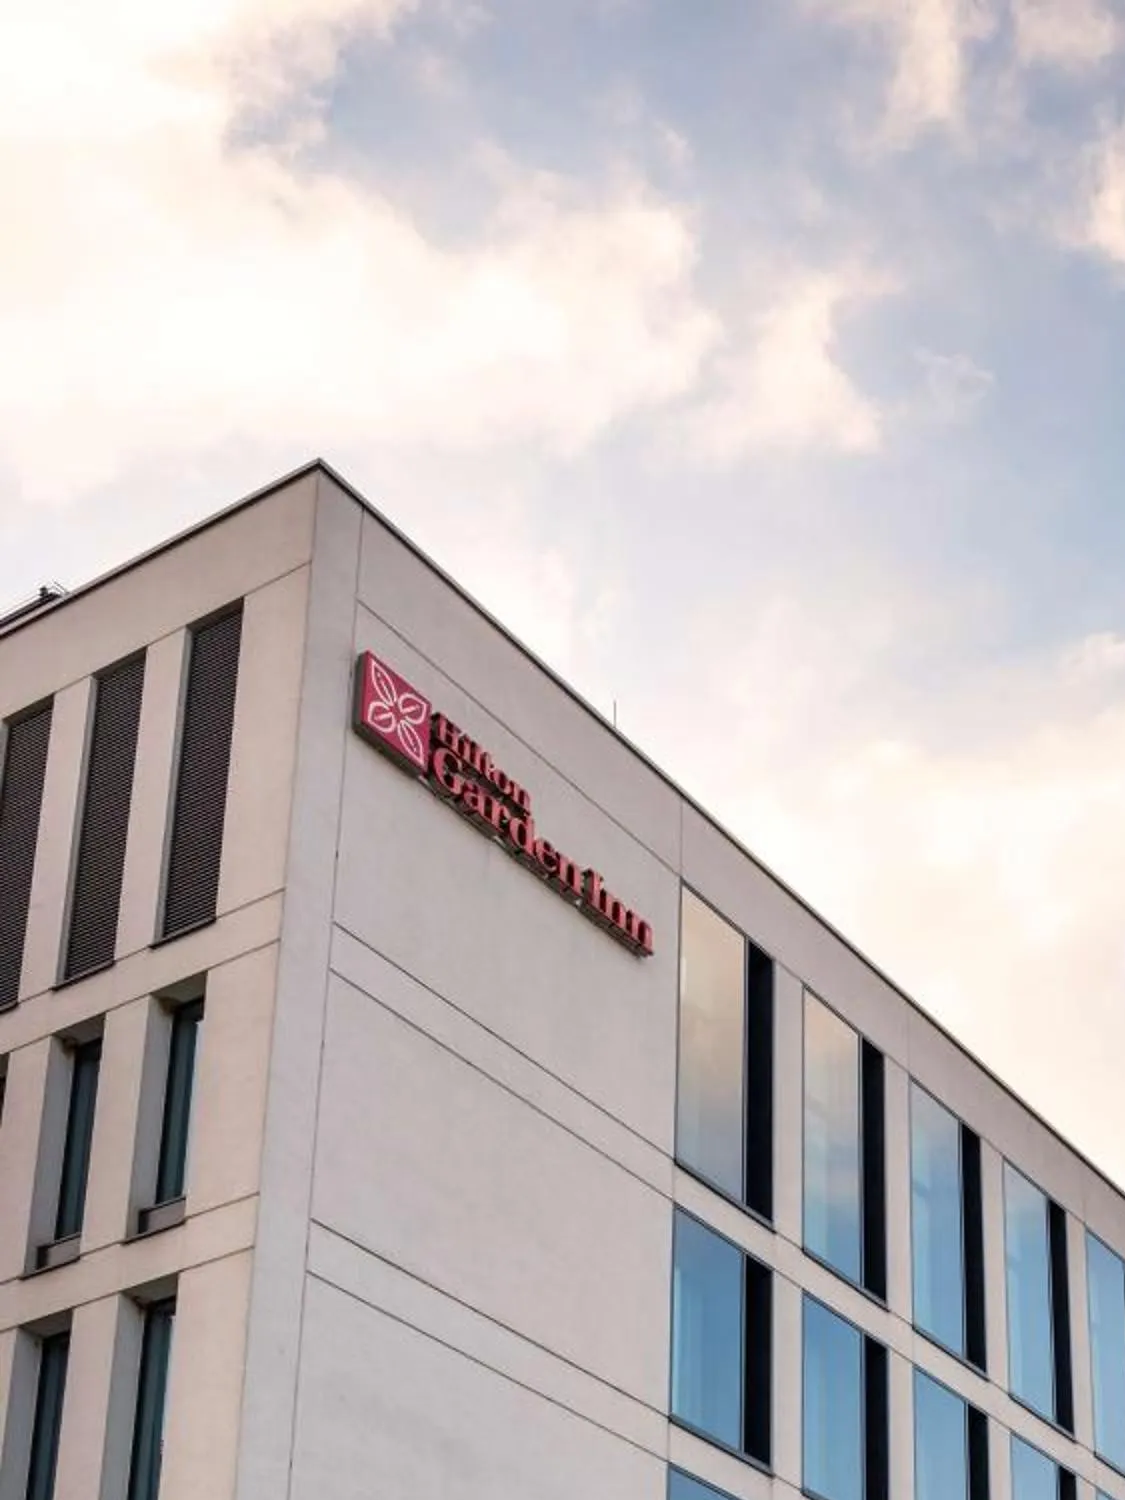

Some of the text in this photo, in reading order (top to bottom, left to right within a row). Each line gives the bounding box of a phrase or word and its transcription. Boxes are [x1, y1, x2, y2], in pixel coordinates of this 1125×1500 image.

[431, 712, 532, 810] Hilton
[430, 748, 654, 956] Garden Inn
